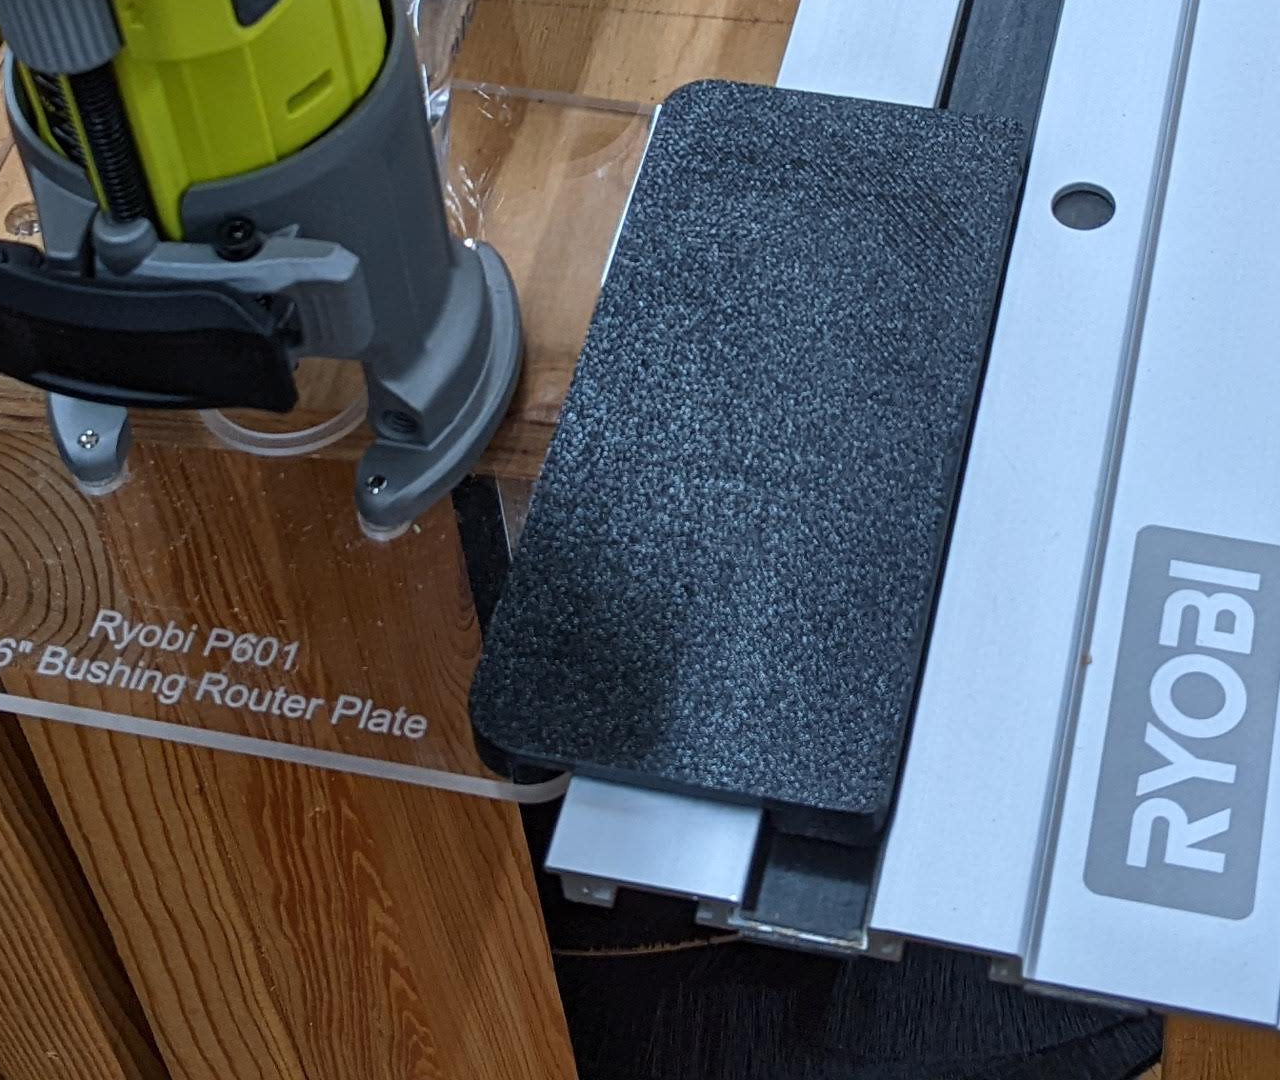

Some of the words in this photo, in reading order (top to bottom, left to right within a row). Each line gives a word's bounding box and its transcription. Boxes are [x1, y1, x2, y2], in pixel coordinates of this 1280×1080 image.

[89, 608, 198, 653] Ryobi
[202, 627, 300, 671] P601
[36, 645, 187, 705] Bushing
[195, 671, 325, 721] Router
[330, 694, 428, 740] Plate
[1126, 559, 1261, 874] RYOBI
